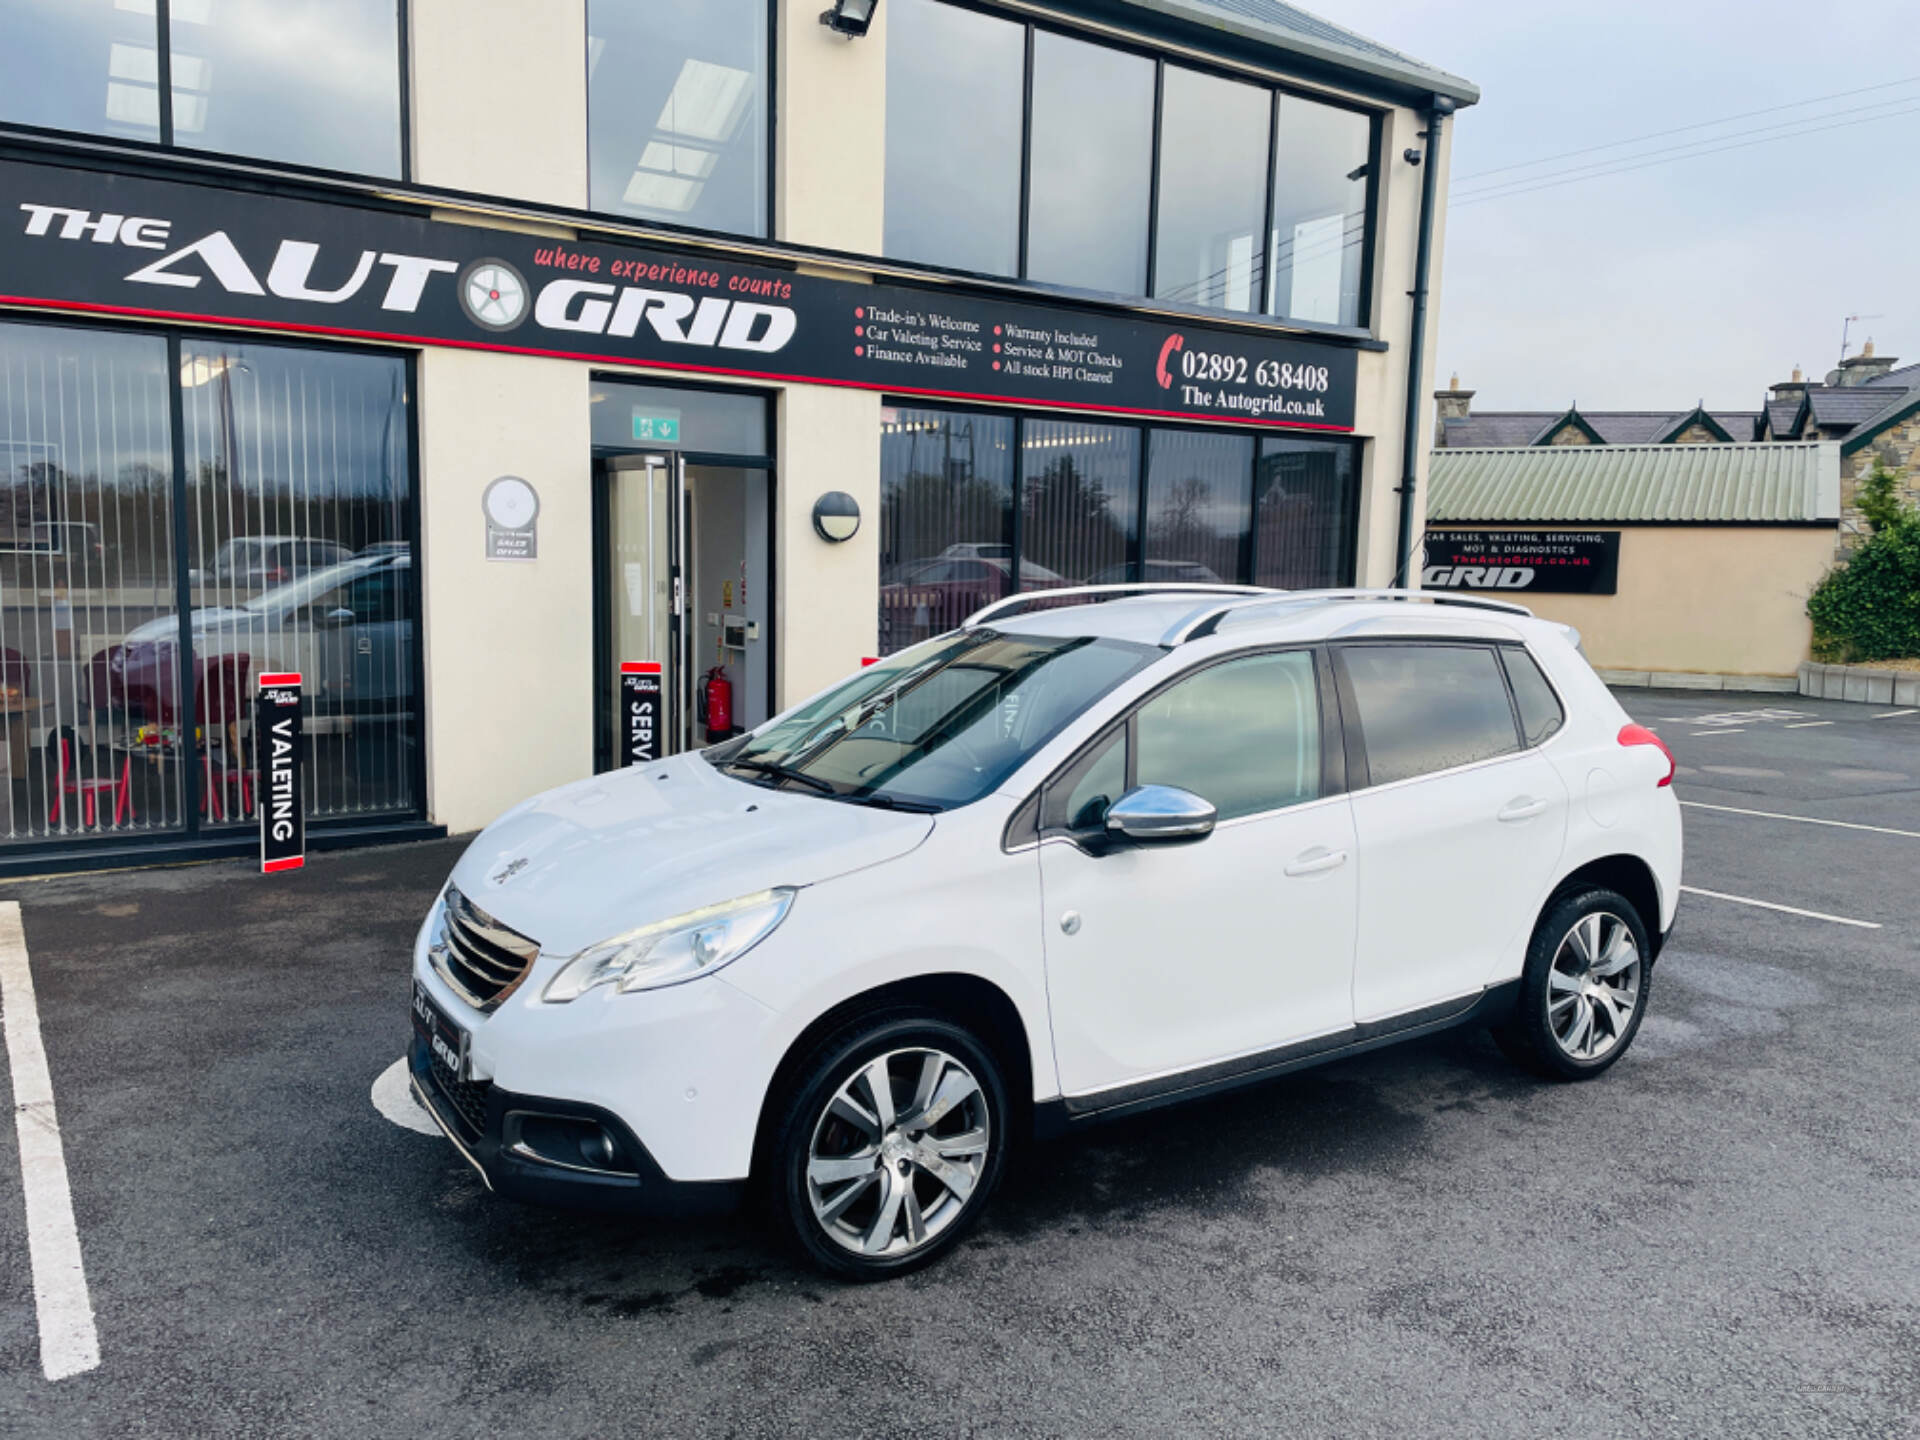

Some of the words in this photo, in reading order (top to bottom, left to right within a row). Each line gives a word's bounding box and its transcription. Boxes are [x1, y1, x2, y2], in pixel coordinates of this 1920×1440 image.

[19, 203, 172, 250] THE
[534, 246, 600, 273] where
[611, 258, 719, 289] experience
[728, 273, 792, 300] counts
[534, 278, 798, 353] GRID
[866, 306, 927, 327] Trade-in's
[929, 313, 980, 333] Welcome
[866, 325, 889, 341] Car
[891, 328, 938, 349] Valeting
[941, 335, 982, 352] Service
[1004, 323, 1051, 344] Warranty
[1054, 329, 1098, 348] Included
[866, 344, 913, 362] Finance
[914, 351, 968, 369] Available
[1003, 342, 1042, 359] Service
[1045, 347, 1055, 360] &
[1058, 349, 1086, 363] MOT
[1087, 352, 1123, 368] Checks
[1003, 360, 1021, 375] All
[1023, 364, 1050, 378] stock
[1052, 365, 1073, 380] HPI
[1075, 368, 1113, 384] Cleared
[1182, 350, 1248, 384] 02892
[1255, 360, 1329, 393] 638408
[1181, 384, 1212, 407] The
[1215, 389, 1325, 417] Autogrid.co.uk
[1425, 533, 1445, 541] CAR
[1463, 545, 1485, 553] MOT
[1504, 545, 1576, 555] DIAGNOSTICS
[1422, 565, 1536, 588] GRID
[271, 718, 293, 842] VALETING
